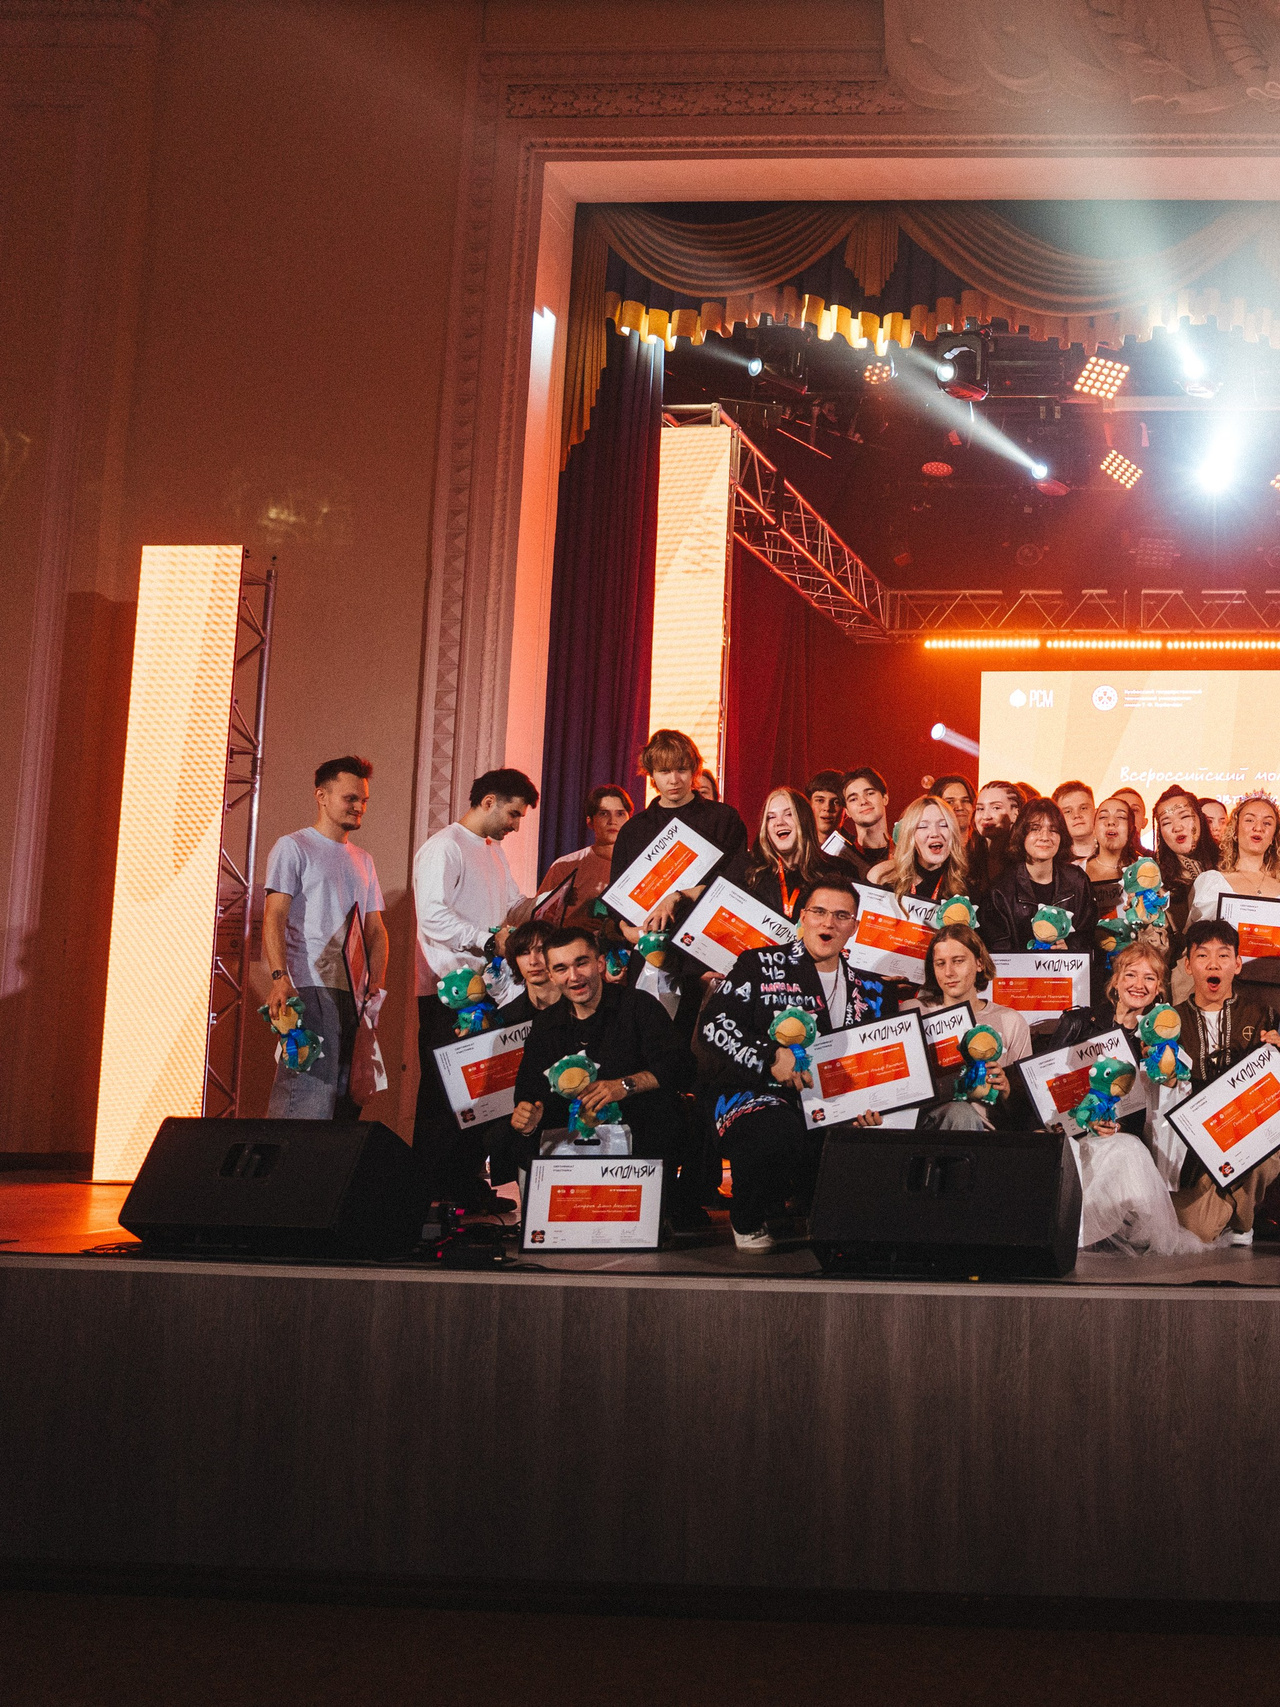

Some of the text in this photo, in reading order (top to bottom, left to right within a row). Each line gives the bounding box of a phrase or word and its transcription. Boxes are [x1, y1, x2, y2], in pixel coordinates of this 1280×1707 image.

[1029, 689, 1053, 708] РСМ
[1120, 766, 1248, 788] Всероссийский
[924, 1014, 963, 1037] СПОЛНЯЙ
